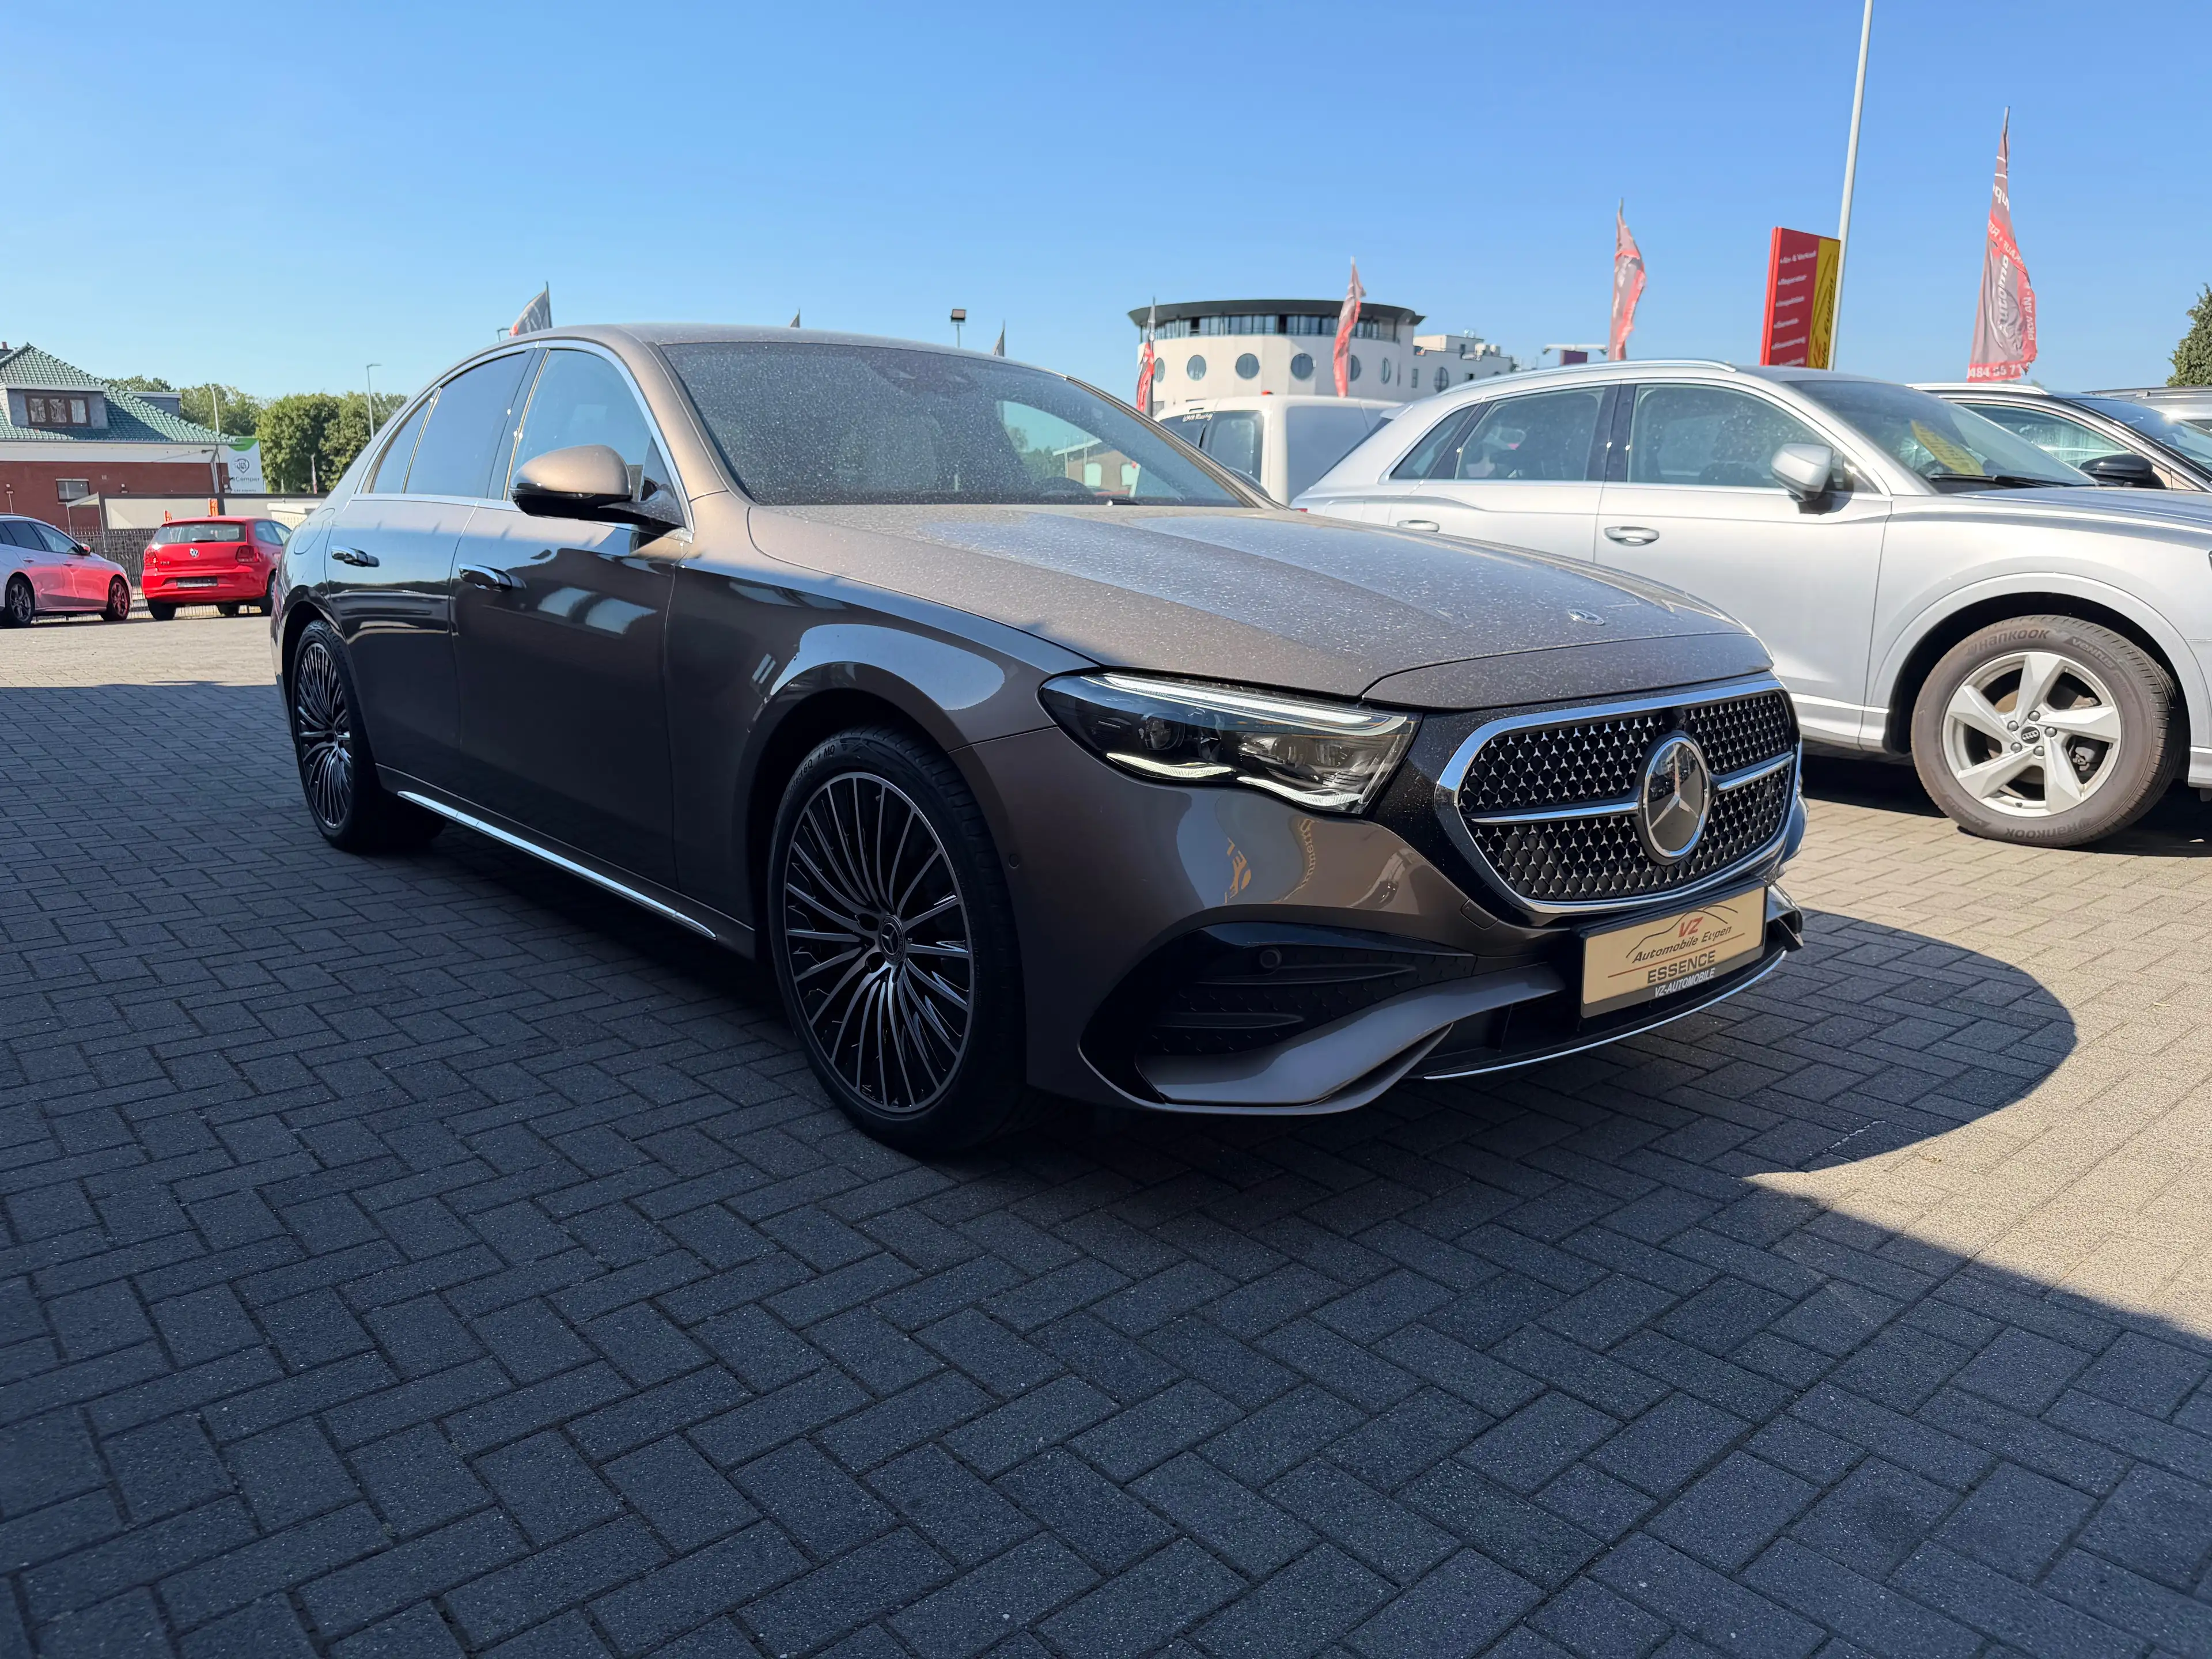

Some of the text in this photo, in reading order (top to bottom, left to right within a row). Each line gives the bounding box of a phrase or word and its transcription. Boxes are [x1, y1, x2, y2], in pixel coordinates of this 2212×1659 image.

[1678, 916, 1703, 938] VZ
[1632, 937, 1698, 964] Automobile
[1647, 950, 1716, 984] ESSENCE
[1654, 968, 1715, 997] VZ-AUTOMOBILE
